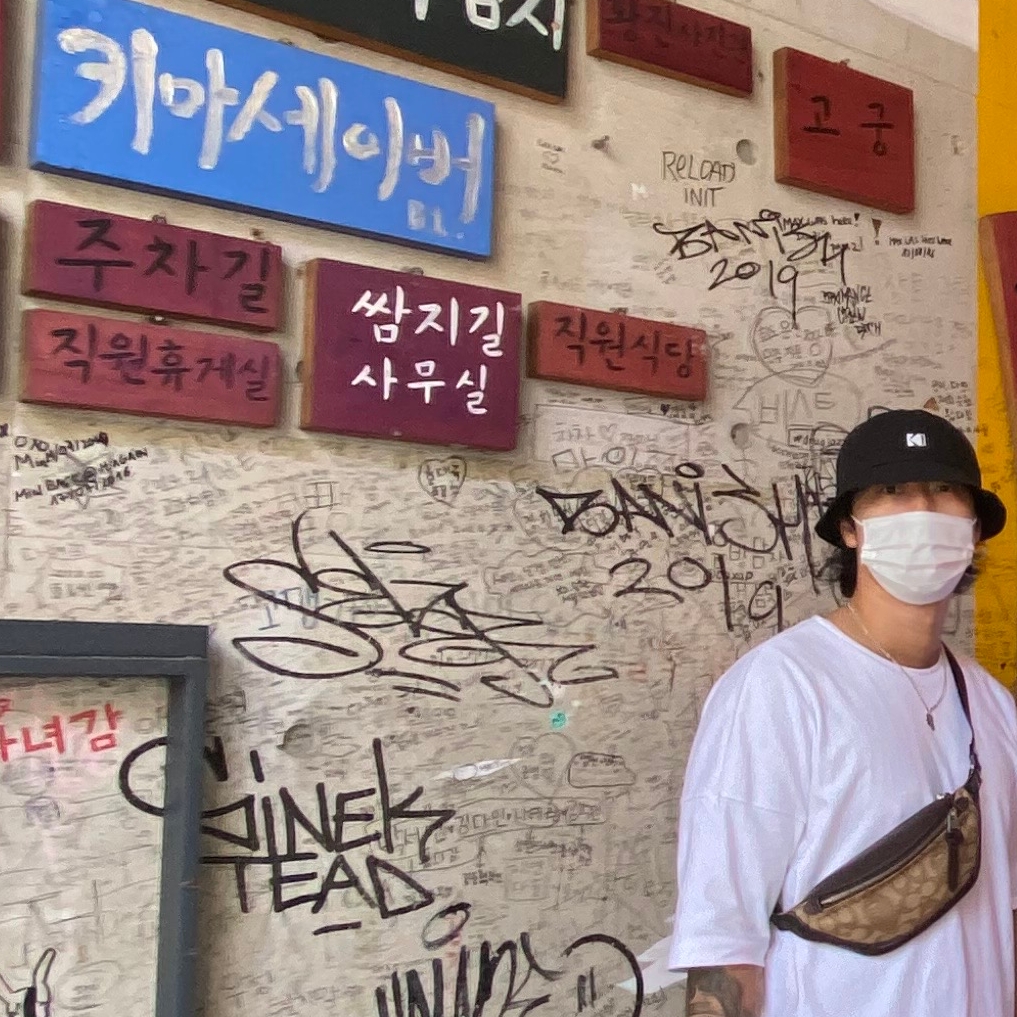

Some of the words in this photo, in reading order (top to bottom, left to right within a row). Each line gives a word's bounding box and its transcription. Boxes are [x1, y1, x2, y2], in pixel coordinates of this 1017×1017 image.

[56, 217, 272, 315] 주차길
[351, 285, 506, 358] 쌈지길
[554, 313, 697, 379] 직원식당
[51, 326, 272, 400] 직원휴게실
[351, 357, 490, 416] 사무실
